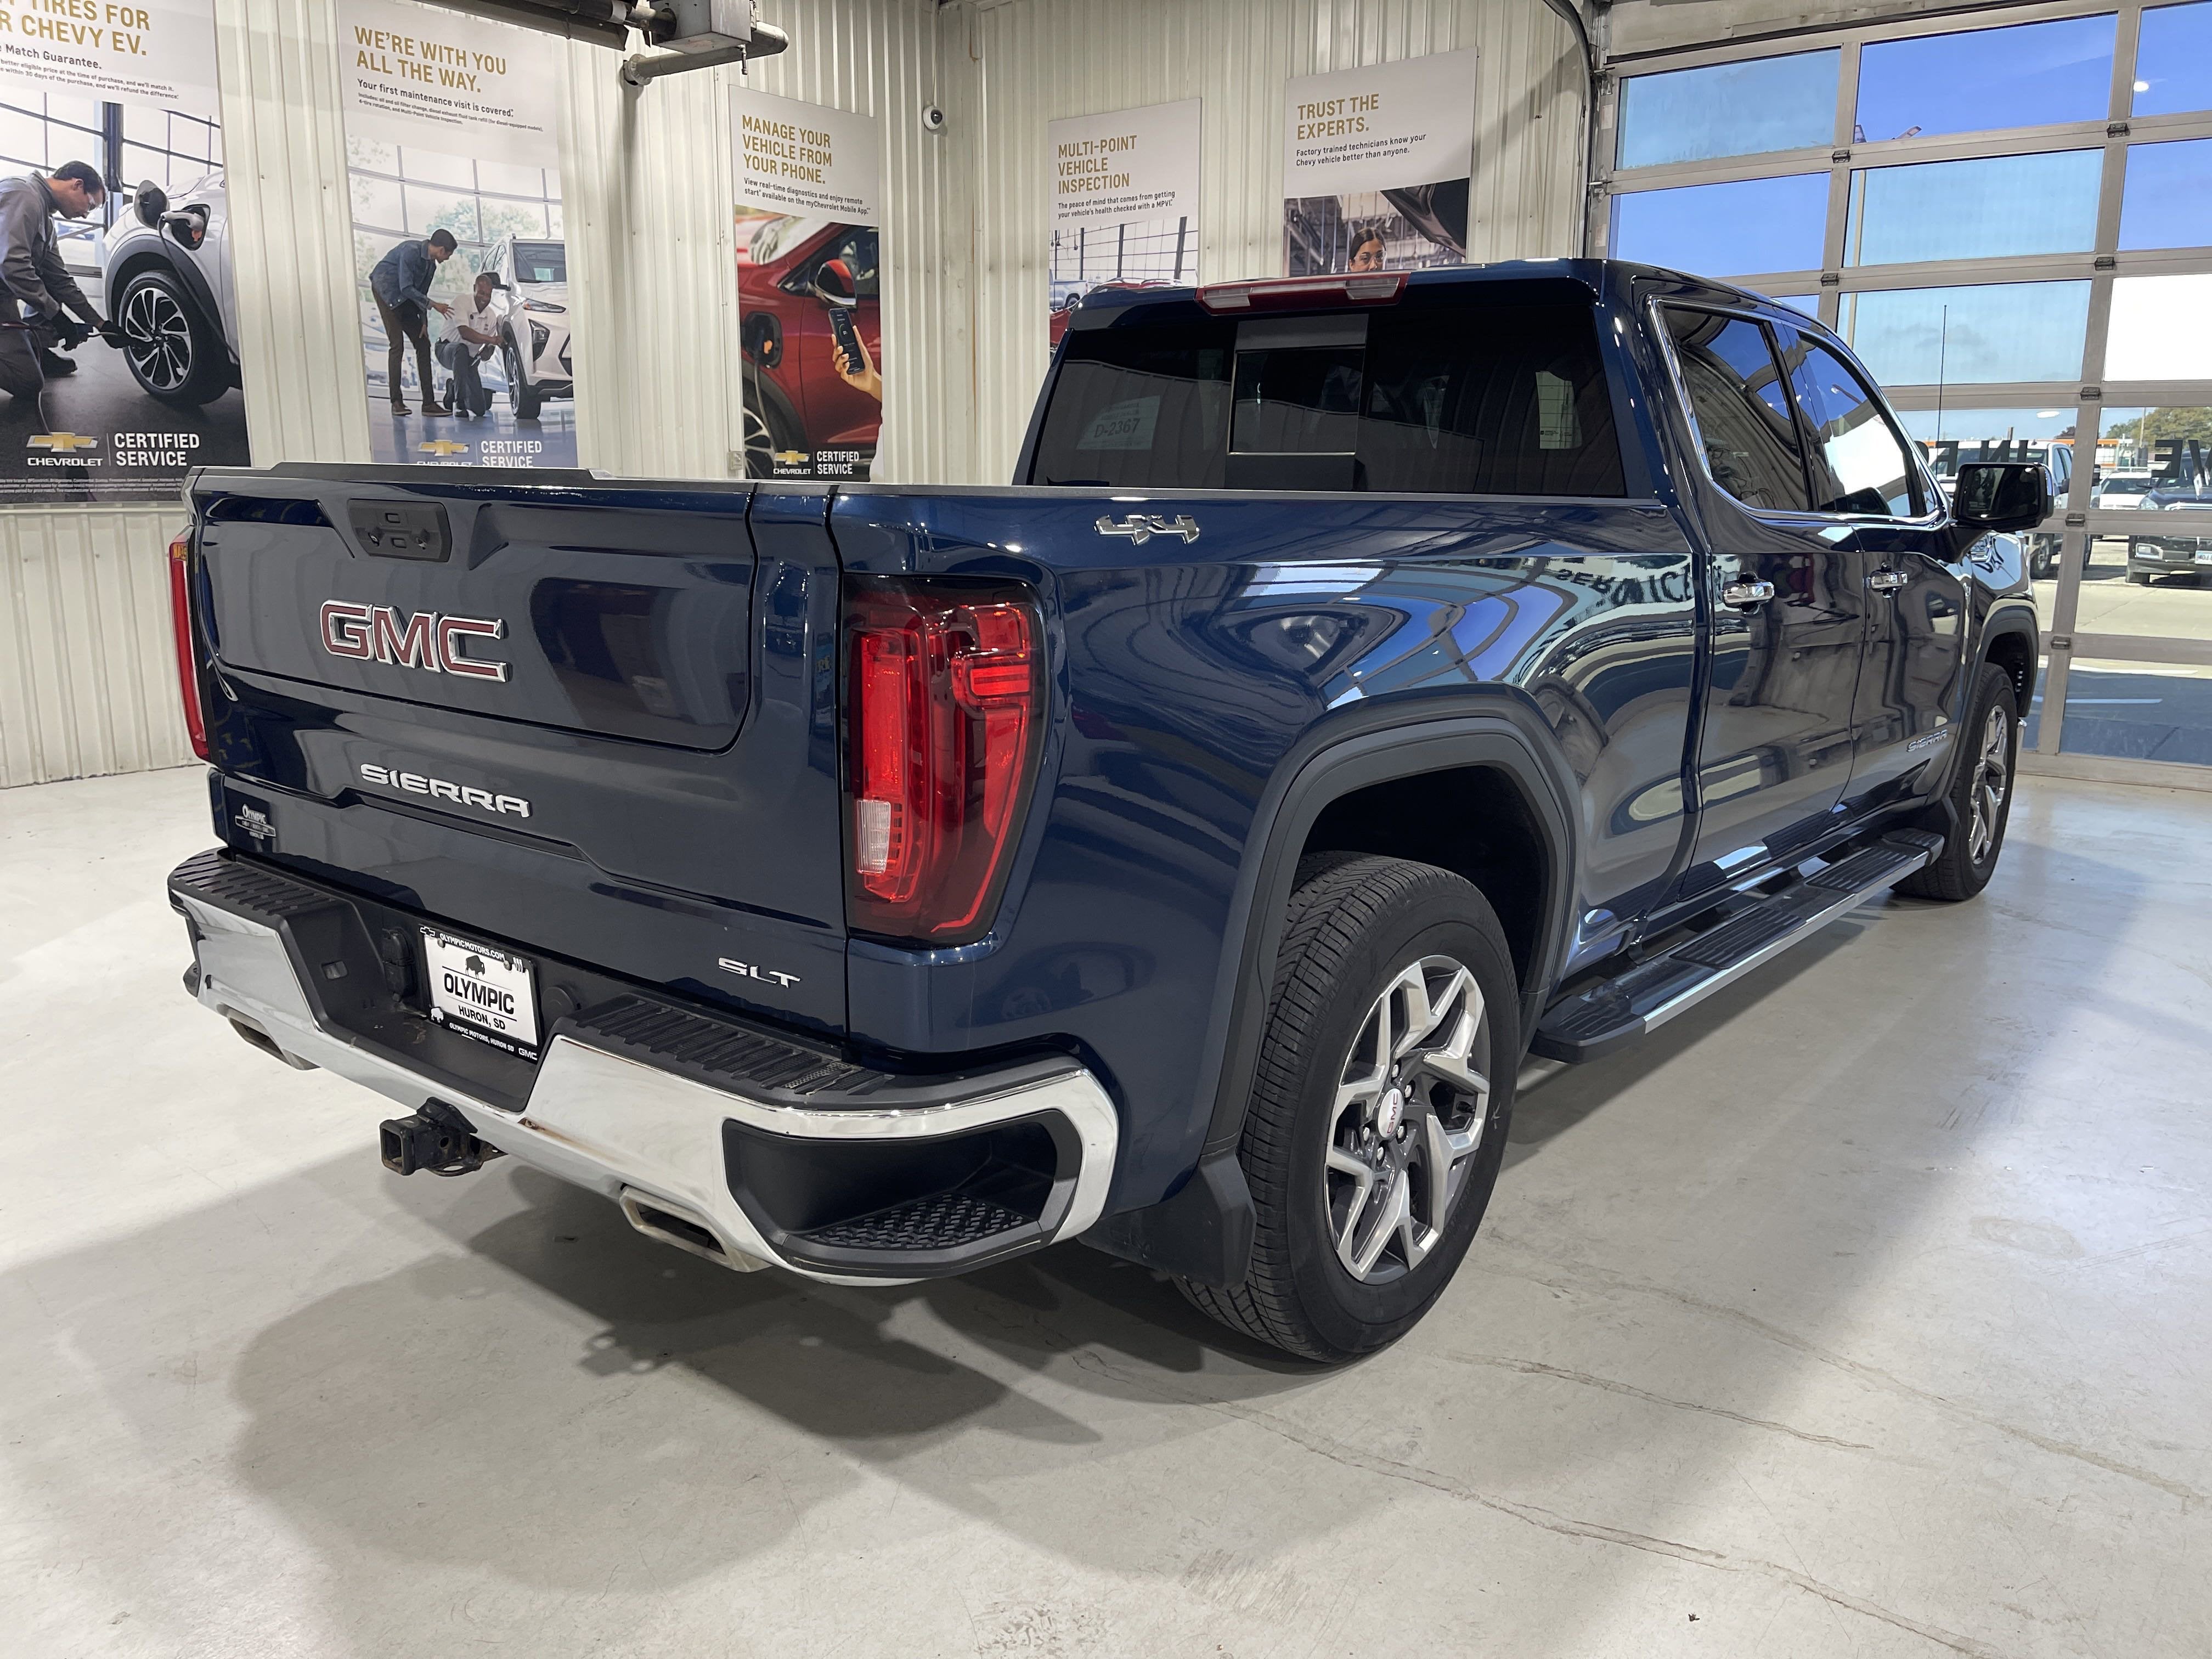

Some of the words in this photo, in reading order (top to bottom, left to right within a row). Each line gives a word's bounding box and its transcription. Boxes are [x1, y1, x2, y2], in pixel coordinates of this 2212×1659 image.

[106, 4, 150, 31] FOR
[21, 15, 104, 48] CHEVY
[112, 31, 146, 55] EV.
[5, 44, 40, 59] Match
[43, 51, 102, 69] Guarantee.
[354, 26, 415, 57] WE'RE
[420, 41, 467, 67] WITH
[472, 52, 506, 75] YOU
[357, 50, 393, 75] ALL
[397, 59, 433, 84] THE
[438, 67, 481, 93] WAY.
[357, 78, 377, 90] Your
[380, 83, 398, 95] first
[400, 90, 452, 106] maintenance
[454, 99, 471, 110] visit
[472, 102, 479, 111] is
[1297, 99, 1345, 120] TRUST
[1350, 93, 1379, 113] THE
[742, 115, 795, 141] MANAGE
[799, 128, 831, 148] YOUR
[1297, 116, 1369, 140] EXPERTS.
[743, 134, 795, 160] VEHICLE
[800, 148, 832, 167] FROM
[1058, 135, 1137, 158] MULTI-POINT
[1296, 148, 1322, 157] Factory
[1323, 144, 1347, 154] trained
[1349, 139, 1388, 151] technicians
[1390, 136, 1408, 146] know
[1410, 134, 1426, 144] your
[1296, 157, 1316, 167] Chevy
[1318, 155, 1341, 165] vehicle
[1342, 153, 1363, 162] better
[1365, 150, 1381, 159] than
[1383, 146, 1410, 157] anyone.
[743, 153, 777, 175] YOUR
[781, 162, 826, 184] PHONE.
[1058, 157, 1108, 176] VEHICLE
[744, 177, 758, 187] View
[759, 180, 785, 193] real-time
[787, 187, 817, 199] diagnostics
[819, 192, 828, 200] and
[830, 194, 843, 204] enjoy
[1058, 173, 1130, 194] INSPECTION
[762, 192, 786, 202] available
[806, 200, 839, 211] myChevrolet
[1058, 201, 1068, 210] The
[1069, 200, 1085, 210] peace
[1093, 198, 1106, 206] mind
[1154, 190, 1175, 200] getting
[1058, 211, 1070, 220] your
[1071, 208, 1094, 217] vehicle's
[1095, 206, 1112, 215] health
[1114, 205, 1136, 213] checked
[1137, 202, 1150, 210] with
[1093, 418, 1141, 438] D-2367
[114, 432, 200, 449] CERTIFIED
[481, 440, 542, 454] CERTIFIED
[27, 457, 103, 467] CHEVROLET
[116, 450, 187, 466] SERVICE
[482, 455, 533, 467] SERVICE
[816, 451, 859, 462] CERTIFIED
[817, 464, 853, 475] SERVICE
[320, 599, 508, 683] GMC
[1907, 729, 1947, 752] SIERRA
[360, 763, 531, 818] SIERRA
[439, 933, 505, 961] OLYMPICMOTORS.COM
[718, 957, 800, 988] SLT
[444, 973, 514, 1014] OLYMPIC
[458, 1005, 492, 1027] HURON,
[494, 1018, 505, 1030] SD
[449, 1022, 469, 1035] OLYMPIC
[469, 1030, 490, 1043] MOTORS,
[490, 1038, 507, 1049] HURON
[507, 1044, 515, 1052] SD
[518, 1047, 537, 1060] GMC
[1387, 1093, 1398, 1134] GMC
